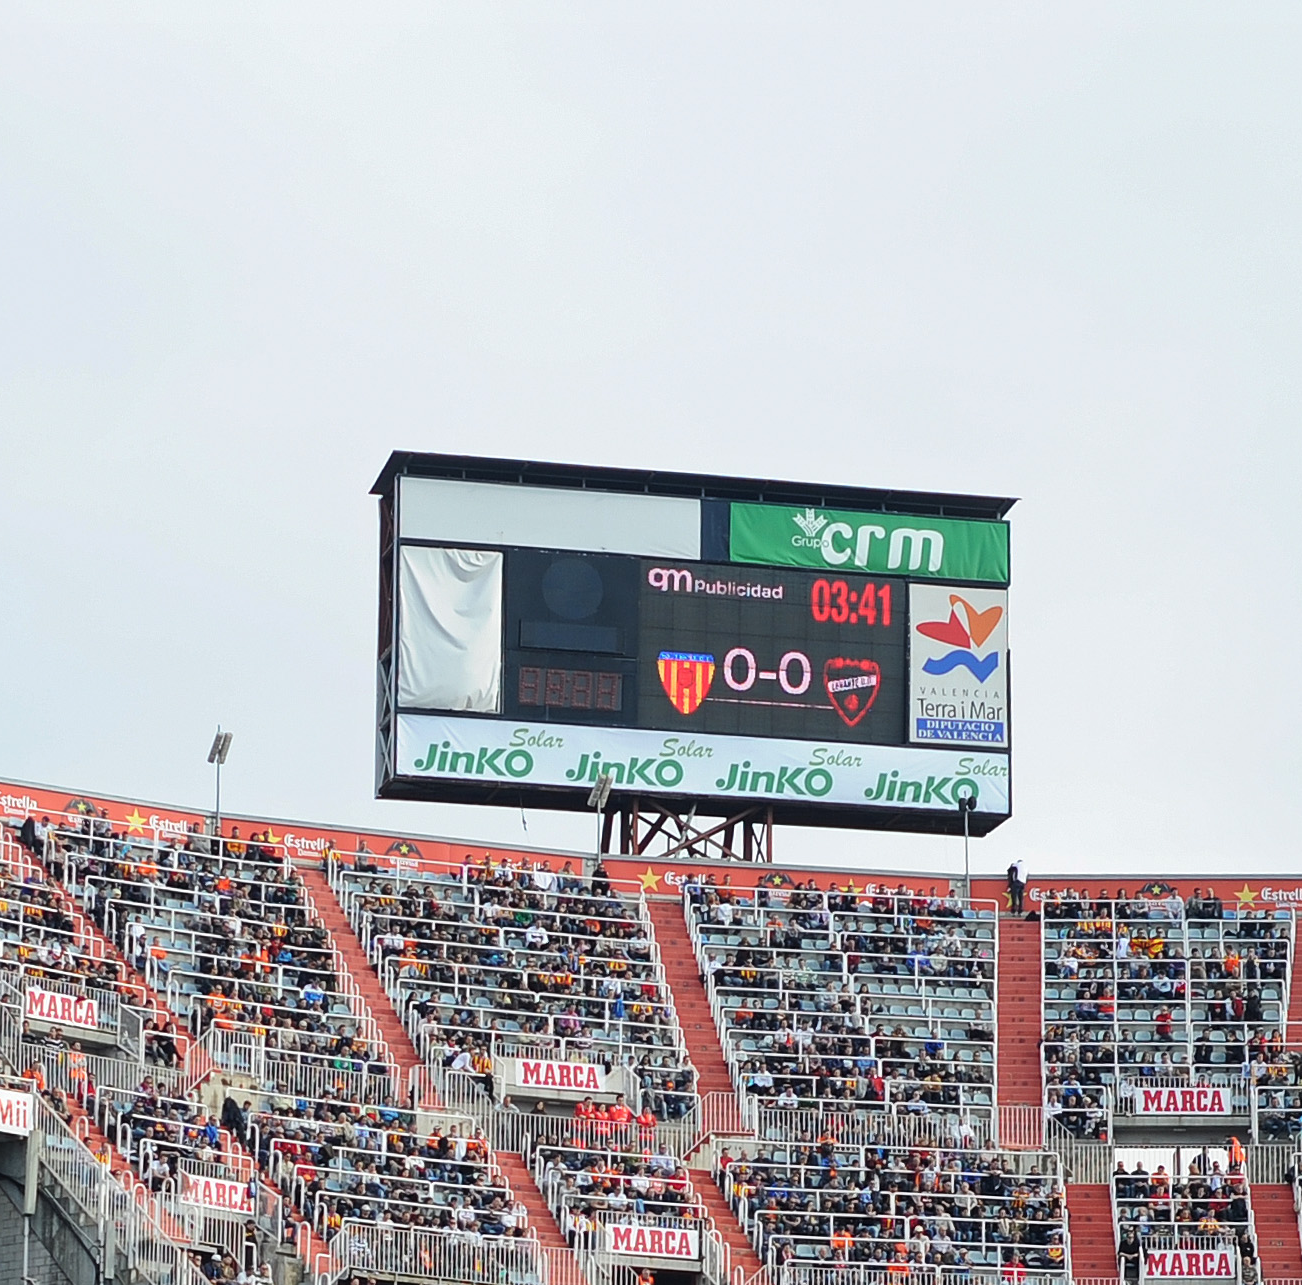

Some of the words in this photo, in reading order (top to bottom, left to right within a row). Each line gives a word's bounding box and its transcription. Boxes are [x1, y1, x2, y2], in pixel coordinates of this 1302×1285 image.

[792, 535, 829, 550] Grupo
[821, 522, 943, 571] crm
[811, 578, 891, 626] 03:41
[723, 647, 812, 695] 0-0
[919, 685, 1000, 698] VALENCIA
[917, 698, 956, 719] Terra
[969, 702, 1003, 721] Mar
[510, 728, 564, 748] Solar
[918, 730, 934, 739] DE
[937, 730, 1003, 742] VALENCIA
[659, 738, 713, 758] Solar
[809, 748, 863, 768] Solar
[955, 757, 1008, 778] Solar
[28, 991, 96, 1026] MARCA
[523, 1063, 599, 1089] MARCA
[1142, 1091, 1224, 1112] MARCA
[612, 1227, 691, 1256] MARCA
[1148, 1253, 1231, 1276] MARCA
